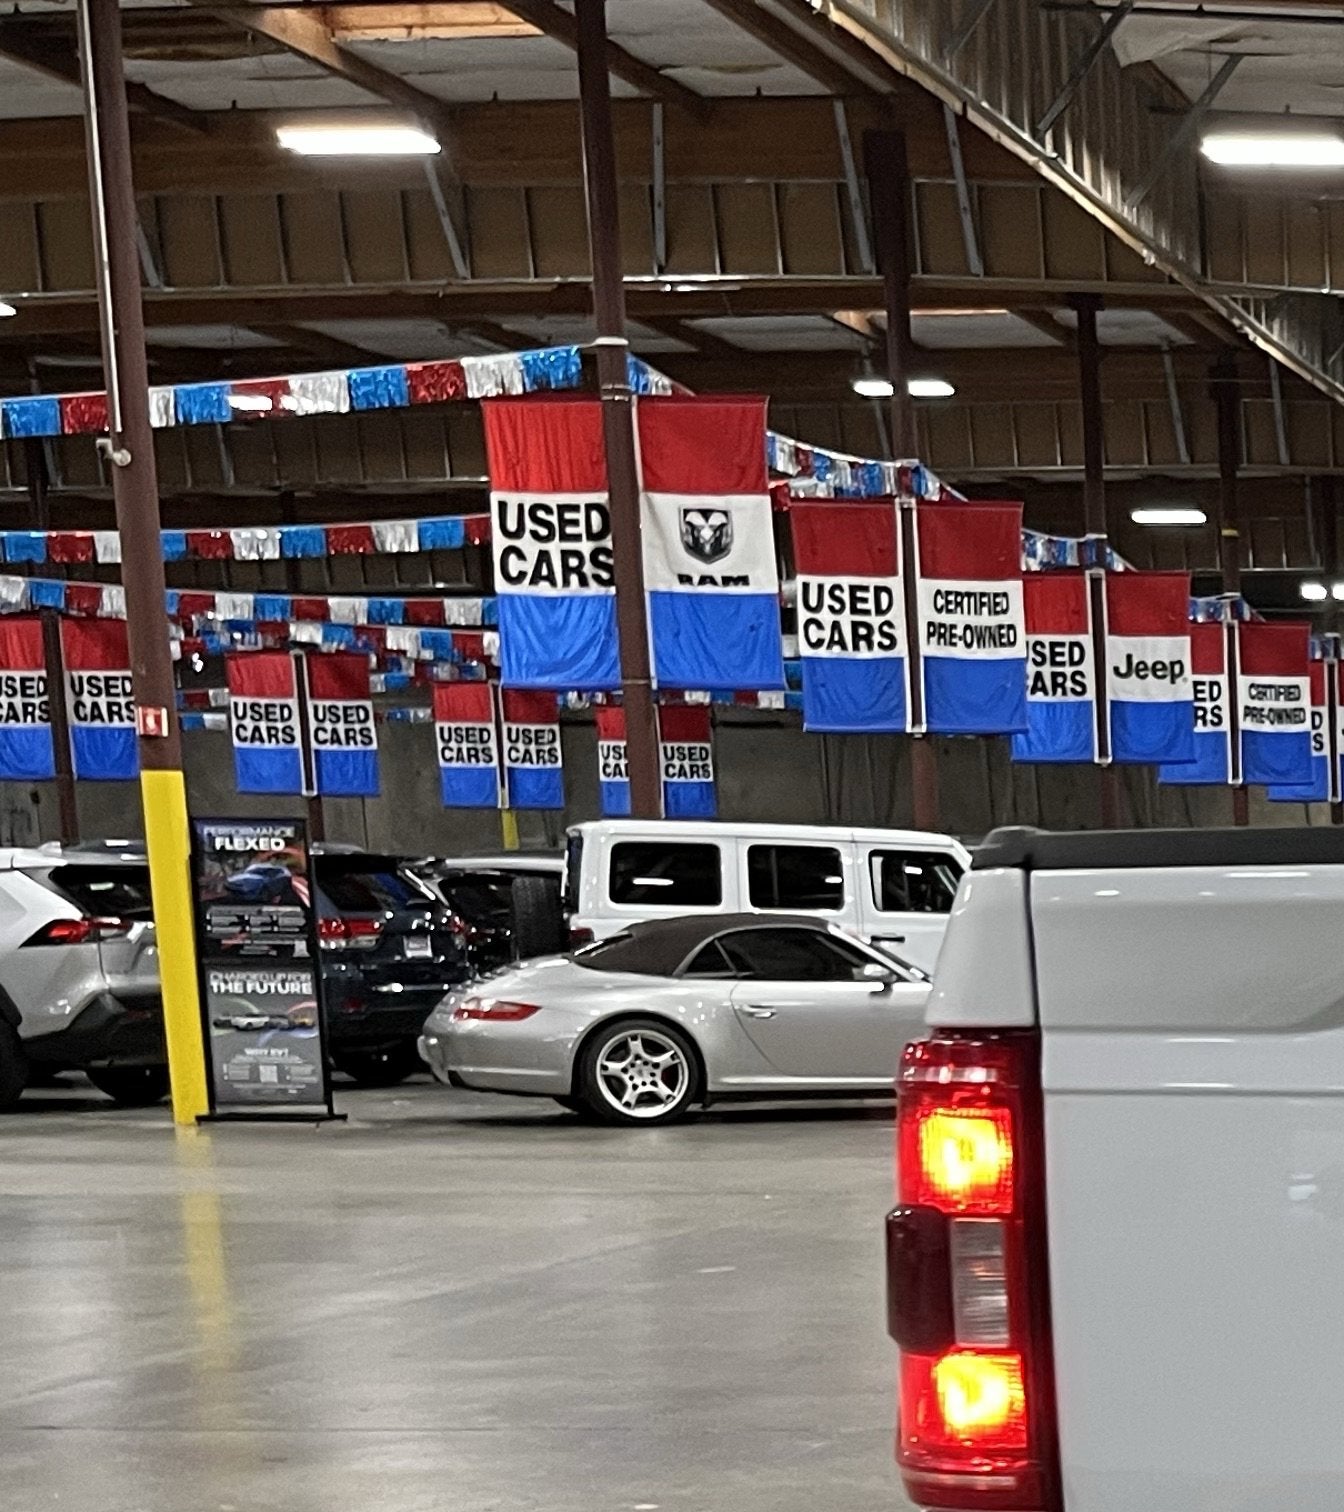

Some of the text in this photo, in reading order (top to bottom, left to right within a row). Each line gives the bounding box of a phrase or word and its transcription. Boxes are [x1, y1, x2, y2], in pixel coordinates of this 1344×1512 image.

[498, 500, 611, 543] USED
[500, 545, 616, 588] CARS
[677, 573, 750, 587] RAM
[802, 582, 893, 616] USED
[933, 589, 1010, 616] CERTIFIED
[803, 618, 898, 652] CARS
[927, 621, 1017, 649] PRE-OWNED
[1026, 640, 1086, 667] SED
[1113, 653, 1185, 685] Jeep
[0, 675, 48, 698] SED
[71, 675, 132, 698] USED
[1028, 670, 1087, 697] ARS
[1192, 680, 1222, 702] ED
[74, 700, 135, 723] CARS
[233, 701, 293, 722] USED
[313, 704, 370, 724] USED
[1193, 704, 1224, 727] RS
[1243, 704, 1307, 726] PRE-OWNED
[235, 723, 296, 744] CARS
[313, 726, 374, 746] CARS
[439, 726, 491, 745] USED
[506, 727, 557, 746] USED
[440, 746, 494, 764] CARS
[507, 746, 559, 764] CARS
[600, 745, 628, 761] US
[662, 745, 710, 761] USED
[602, 762, 629, 778] CA
[664, 762, 711, 779] CARS
[214, 836, 286, 851] FLEXED
[210, 981, 313, 995] THE FUTURE
